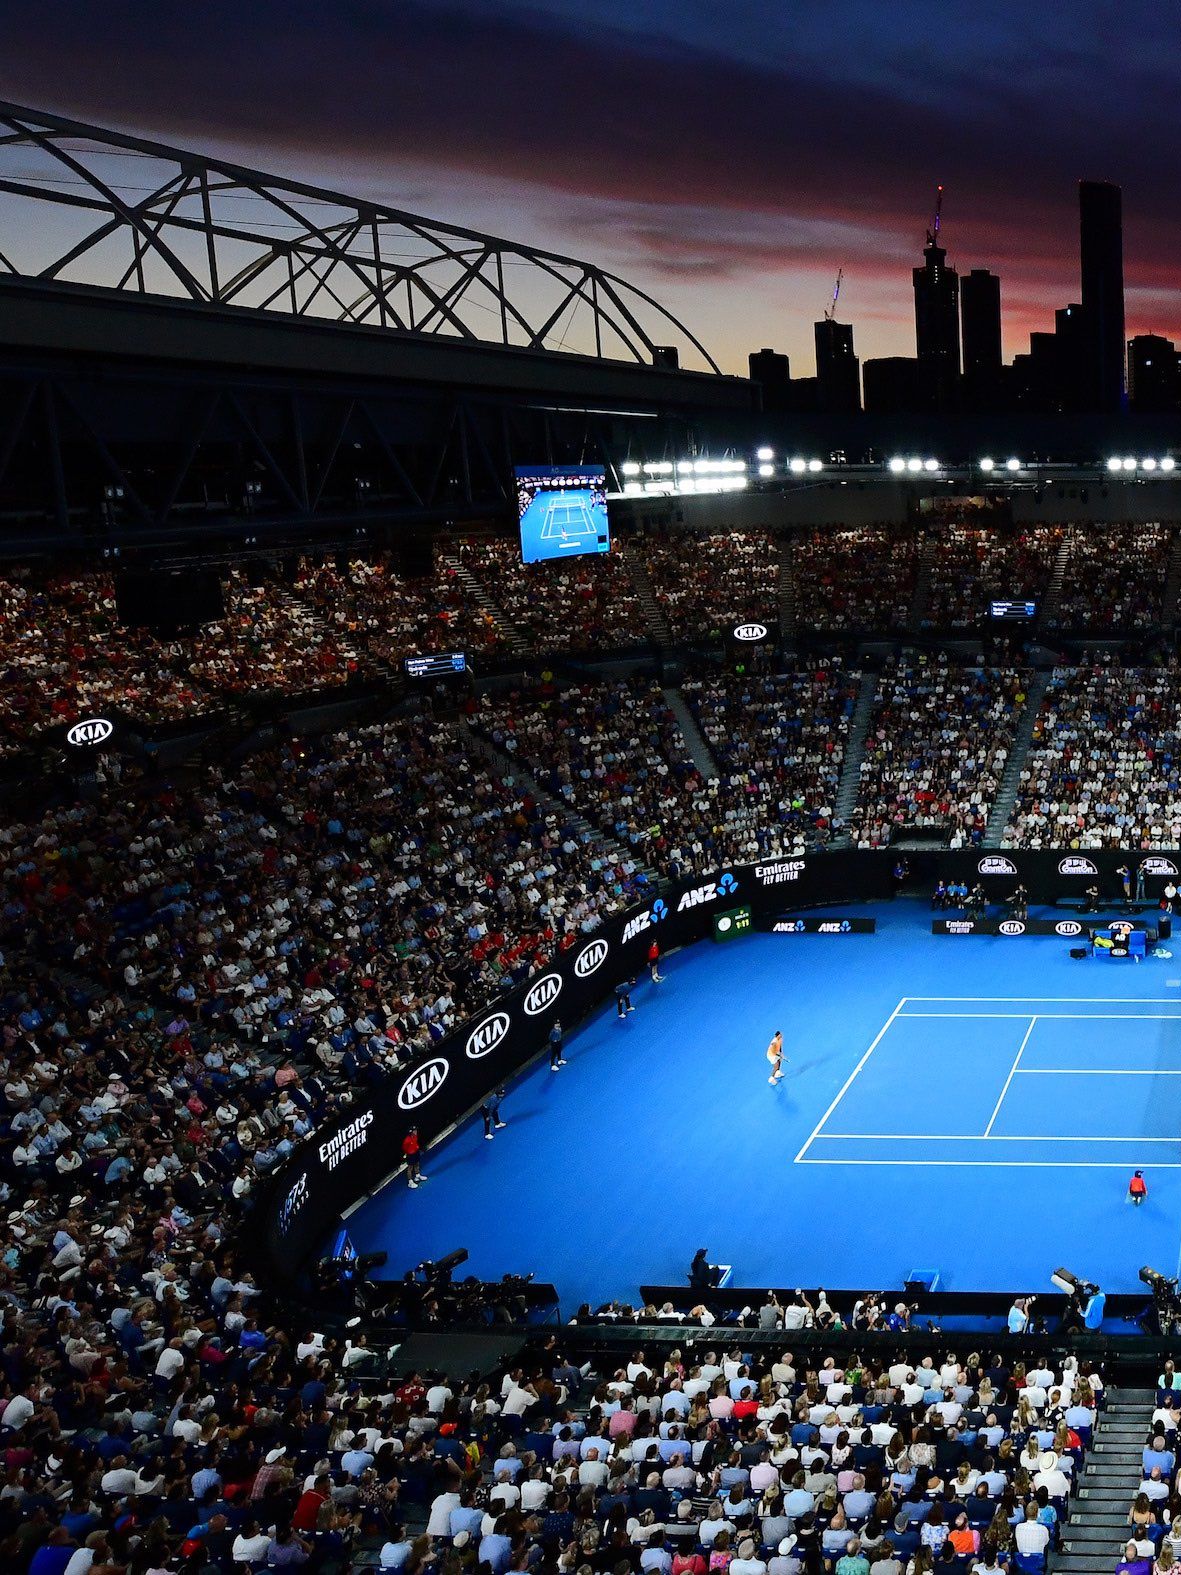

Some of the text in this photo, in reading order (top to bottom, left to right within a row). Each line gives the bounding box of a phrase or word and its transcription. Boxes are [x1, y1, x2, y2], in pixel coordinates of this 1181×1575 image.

[755, 861, 805, 878] Emirates
[763, 870, 798, 885] FLY BETTER
[677, 882, 717, 912] ANZ
[622, 911, 651, 944] ANZ
[773, 922, 796, 932] ANZ
[818, 922, 841, 932] ANZ
[319, 1110, 374, 1163] Emirates
[328, 1129, 367, 1171] FLY BETTER
